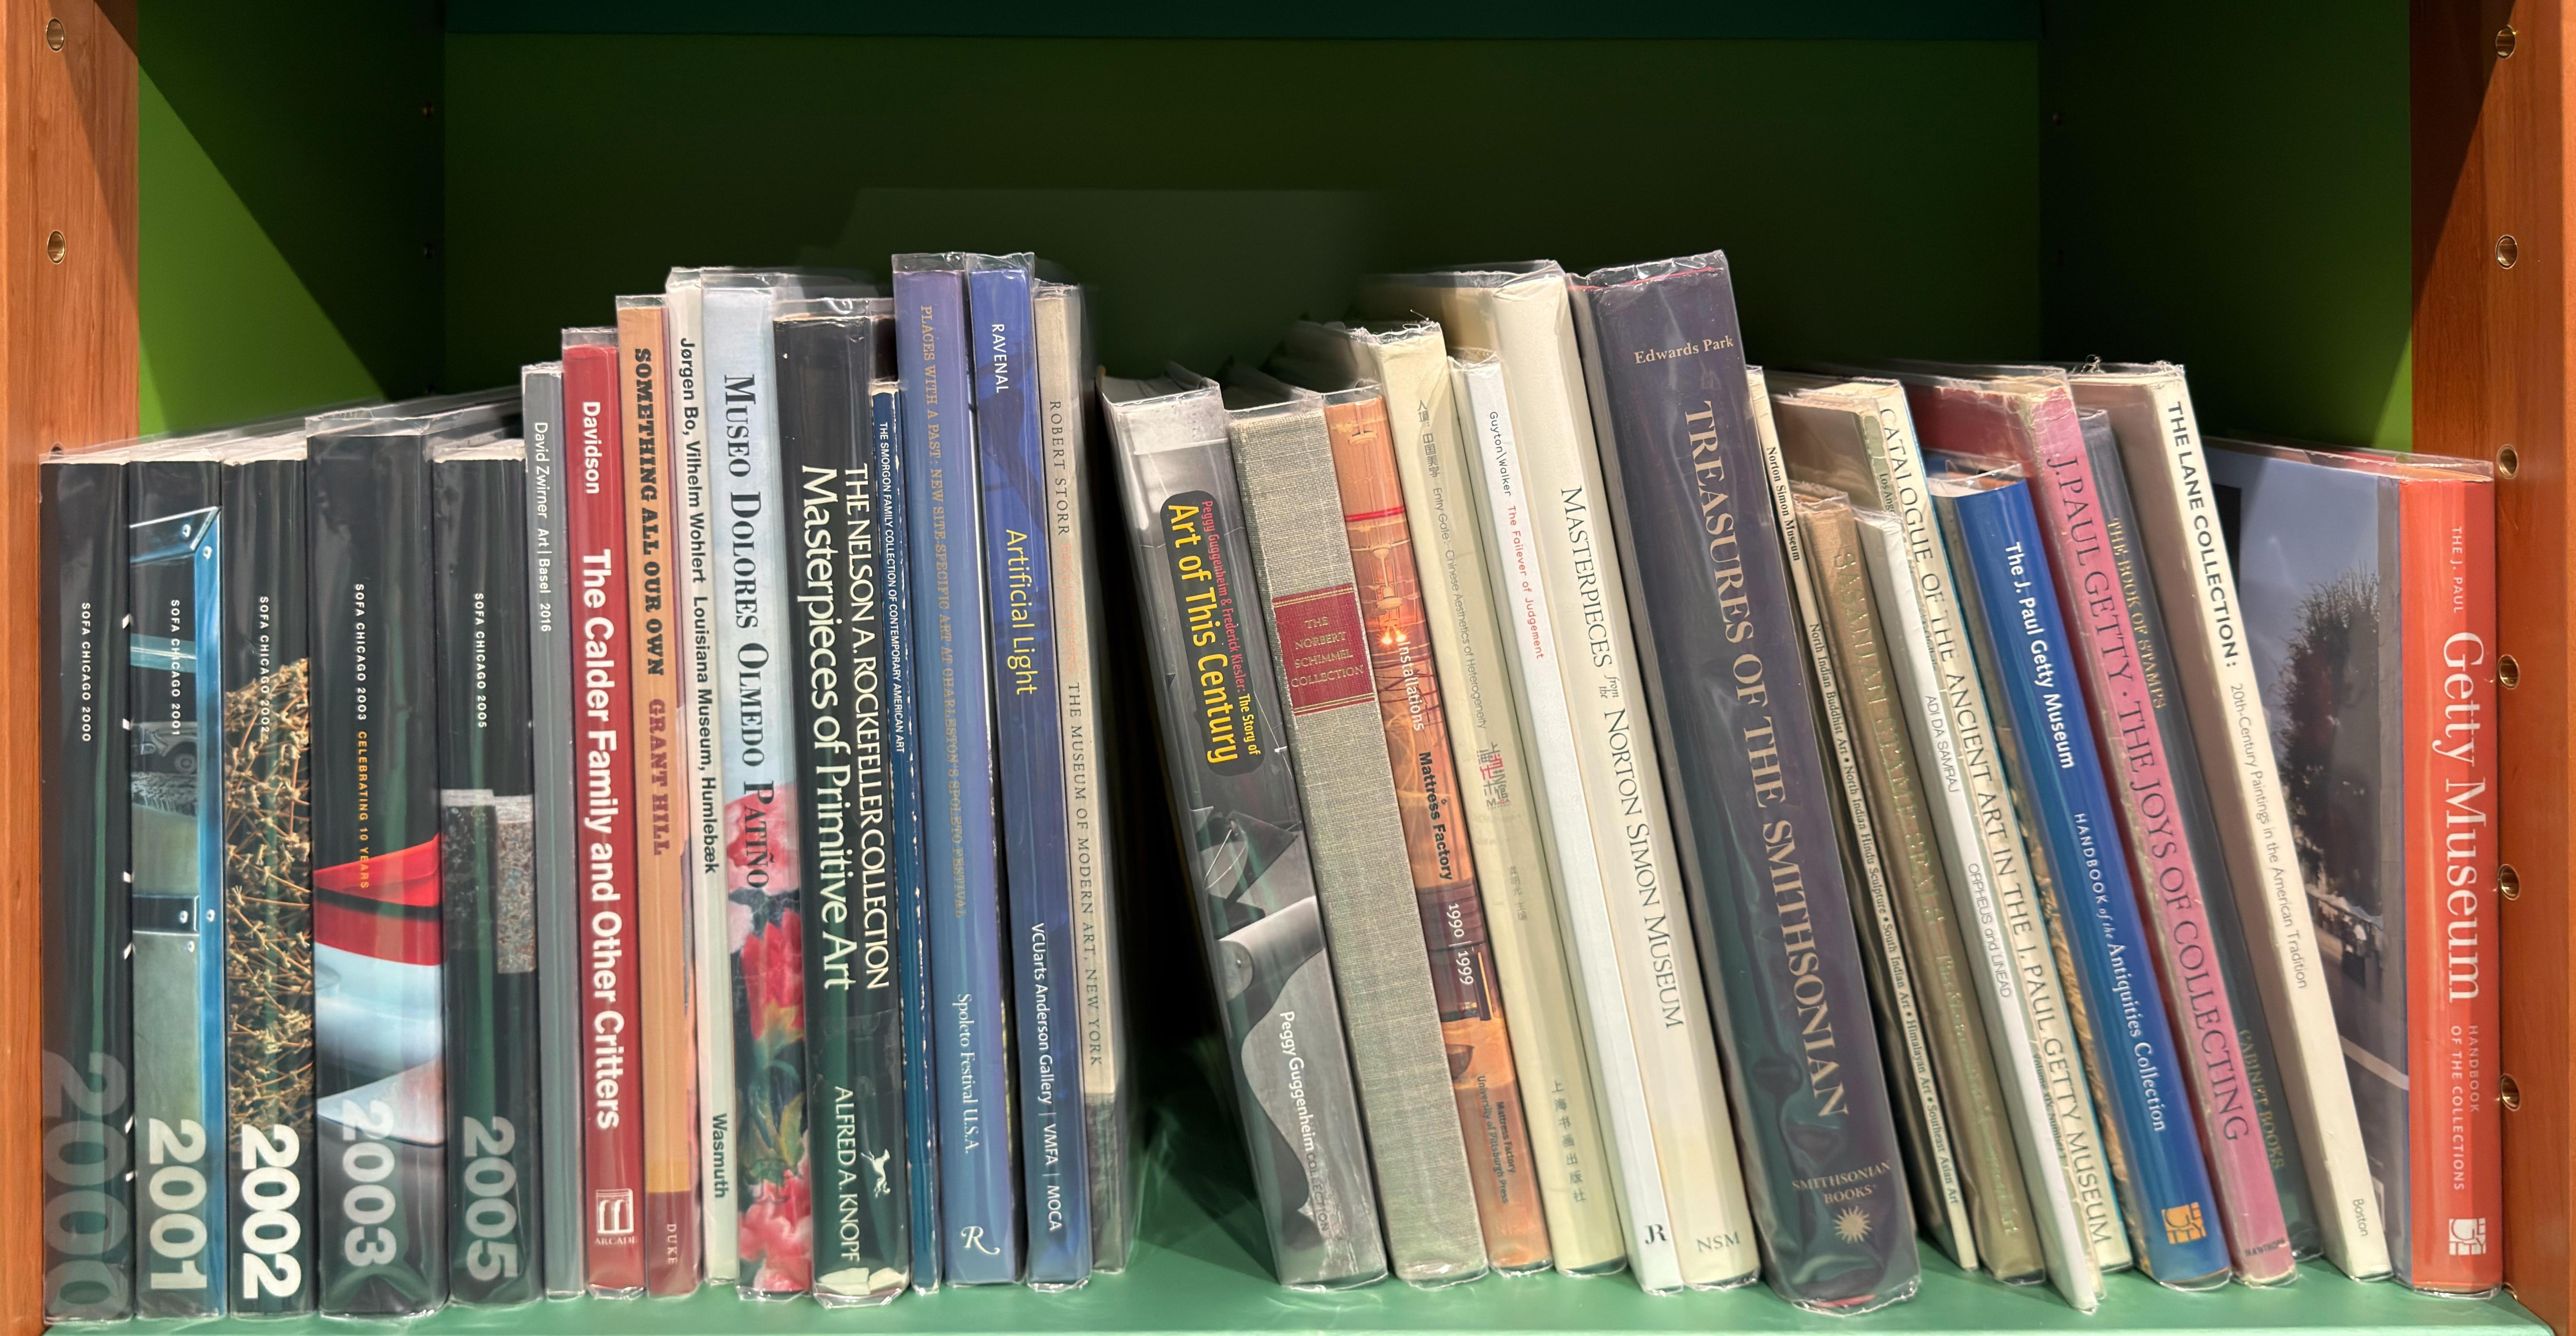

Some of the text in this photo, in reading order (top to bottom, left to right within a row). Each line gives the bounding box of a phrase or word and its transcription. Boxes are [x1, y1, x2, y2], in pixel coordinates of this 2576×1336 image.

[991, 323, 1009, 394] RAVENAL
[1634, 335, 1734, 364] Edwards Park
[1049, 401, 1070, 536] ROBERT STORR
[1421, 433, 1440, 478] 中国美学
[1766, 446, 1802, 562] Norton Simon Museum
[1875, 406, 1935, 564] CATALOGUE
[2055, 476, 2105, 568] PAUL
[535, 422, 553, 632] David Zwirner Art Basel 2016
[879, 422, 905, 753] THE SMORGON FAMILY COLLECTION OF CONTEMPORARY AMERICAN ART
[1486, 410, 1546, 660] Guyton\Walker The Failever of Judgement
[1918, 571, 1944, 604] OF
[2166, 401, 2241, 669] THE LANE COLLECTION:
[2451, 527, 2464, 613] THE J. PAUL
[635, 348, 670, 856] SOMETHING ALL OUR OWN GRANT HILL
[676, 337, 720, 874] Jørgen Bo, Vilhelm Wohlert Louisiana Museum, Humlebæk
[1005, 528, 1038, 696] Artificial Light
[1167, 500, 1245, 764] Art of This Century
[1198, 499, 1261, 757] Peggy Guggenheim & Frederick Kiesler: The Story of
[1294, 632, 1346, 650] NORBERT
[1294, 649, 1353, 668] SCHIMMEL
[1304, 616, 1329, 629] THE
[1431, 487, 1487, 730] Entry Gate: Chinese Aesthetics of Heterogeneity
[1928, 608, 1960, 663] THE
[2003, 541, 2079, 771] The J. Paul Getty Museum
[2079, 568, 2137, 688] GETTY
[82, 603, 91, 742] SOFA CHICAGO 2000
[355, 583, 370, 889] SOFA CHICAGO 2003 CELEBRATING 10 YEARS
[845, 463, 890, 989] THE NELSON A. ROCKEFELLER COLLECTION
[1291, 665, 1364, 687] COLLECTION
[1943, 669, 1993, 786] ANCIENT
[2114, 700, 2158, 774] THE
[581, 402, 627, 1130] Davidson The Calder Family and Other Critters
[1397, 641, 1474, 986] Installations Mattress Factory 1990 1999
[1559, 484, 1688, 1029] MASTERPIECES from the NORTON SIMON MUSEUM
[1682, 400, 1850, 1121] TREASURES OF THE SMITHSONIAN
[1975, 787, 2010, 848] ART
[2128, 774, 2180, 862] JOYS
[2430, 631, 2489, 1004] Getty Museum
[1923, 693, 2013, 999] ADI DA SAMRAJ ORPHEUS and LINEAD
[1992, 848, 2017, 878] IN
[2156, 864, 2194, 916] OF
[2226, 683, 2311, 989] 20th-Century Paintings in the American Tradition
[2000, 881, 2033, 937] THE
[2016, 943, 2039, 961] J.
[2021, 962, 2058, 1031] PAUL
[2166, 917, 2254, 1143] COLLECTING
[951, 993, 981, 1153] Spoleto Festival U.S.A.
[1550, 1079, 1586, 1204] 上海书画出版社
[2040, 1035, 2083, 1125] GETTY
[148, 1118, 207, 1290] 2001
[241, 1123, 301, 1298] 2002
[340, 1098, 397, 1267] 2003
[462, 1114, 518, 1281] 2005
[2064, 1128, 2115, 1245] MUSEUM
[2350, 1197, 2370, 1238] Boston
